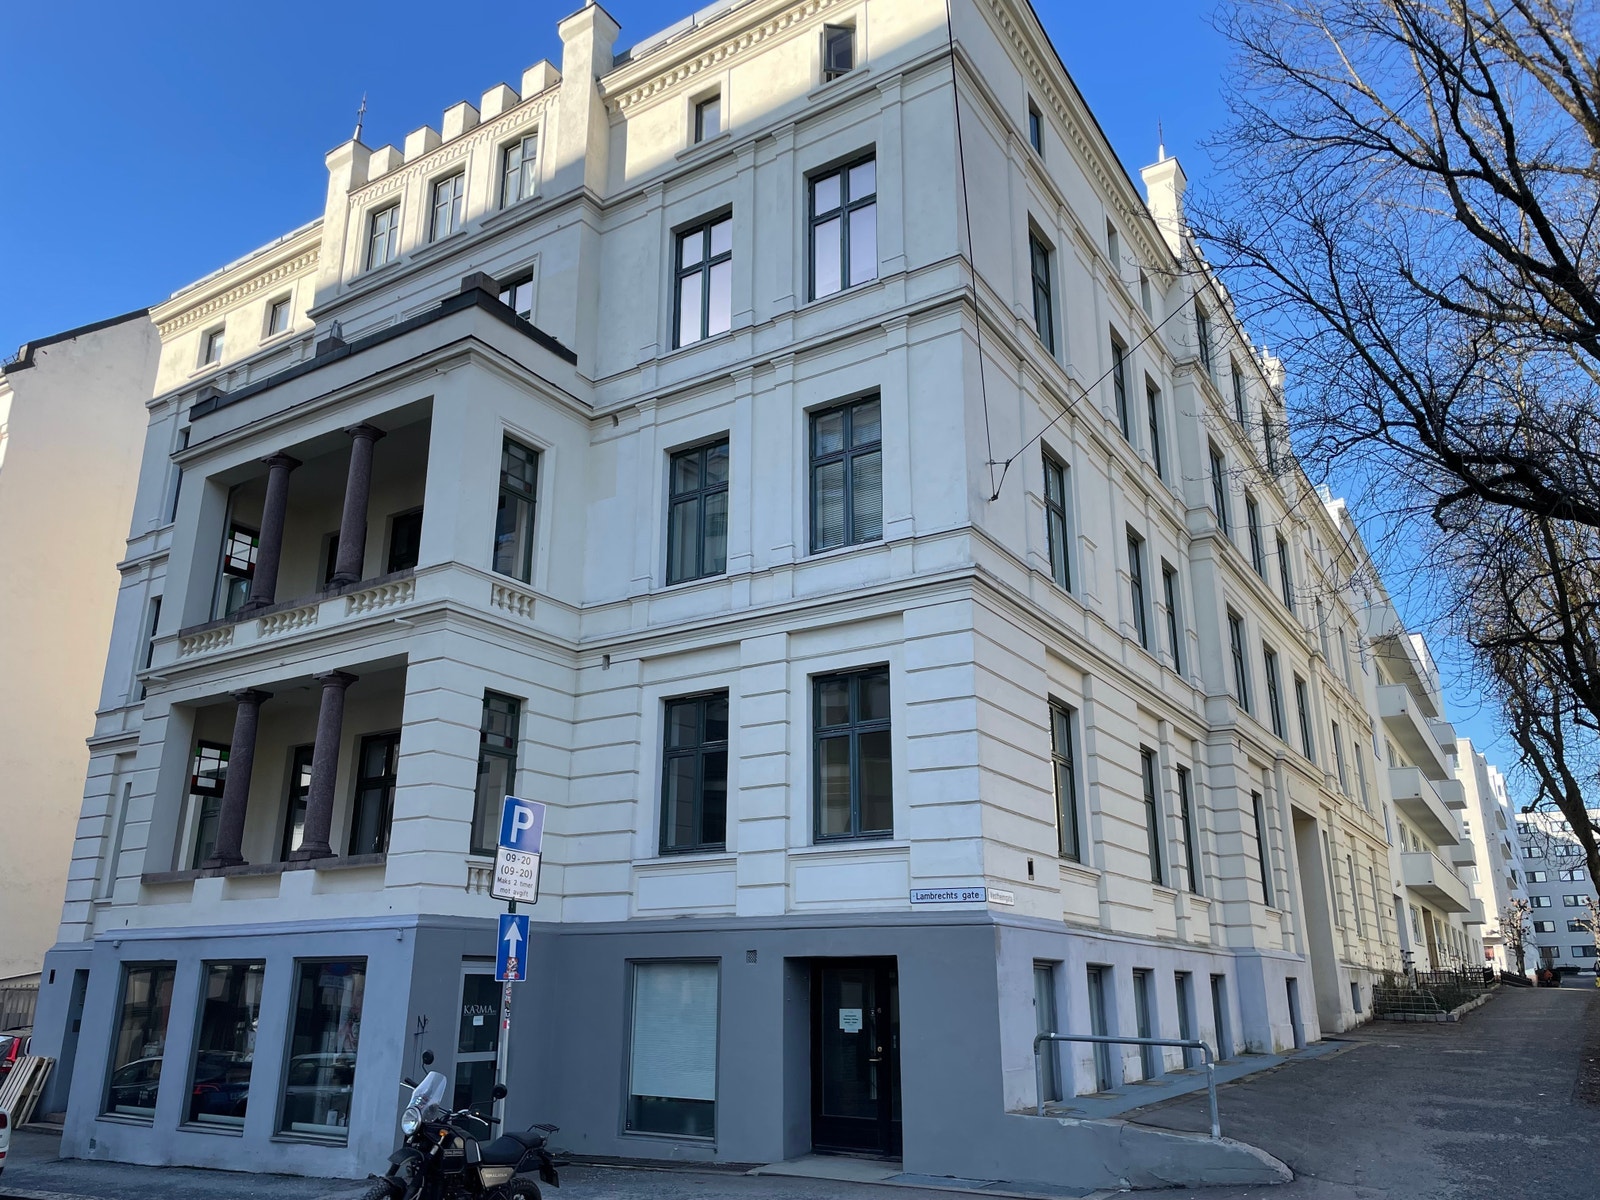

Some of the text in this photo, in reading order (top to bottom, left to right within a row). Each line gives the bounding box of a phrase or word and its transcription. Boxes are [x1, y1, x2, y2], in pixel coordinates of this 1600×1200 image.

[510, 804, 534, 843] P
[505, 853, 531, 865] 09-20
[500, 865, 533, 879] (09-20)
[497, 876, 511, 885] Maks
[513, 889, 529, 898] avgift
[915, 891, 980, 901] Lambrechts gate
[464, 1004, 493, 1014] KARMA
